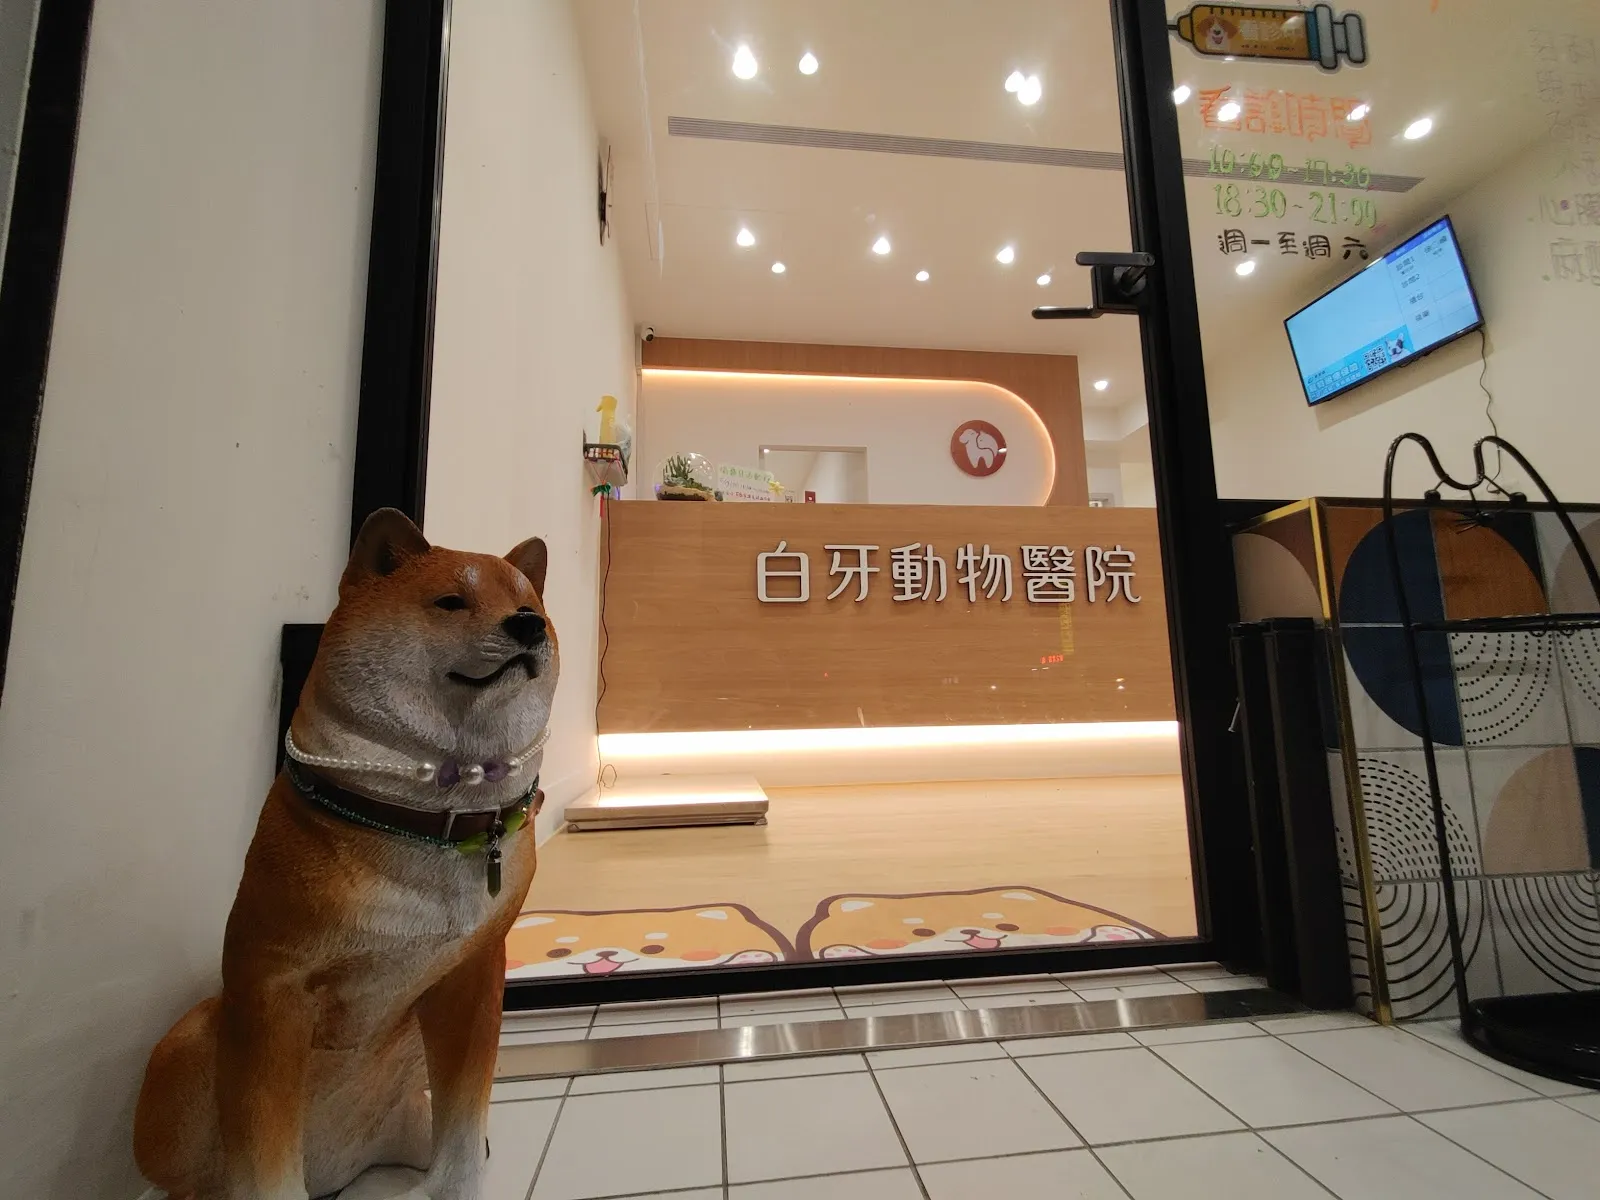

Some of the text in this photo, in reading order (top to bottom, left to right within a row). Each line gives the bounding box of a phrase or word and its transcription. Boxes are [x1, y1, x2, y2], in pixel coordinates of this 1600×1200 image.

[757, 540, 1142, 603] 白牙動物醫院
